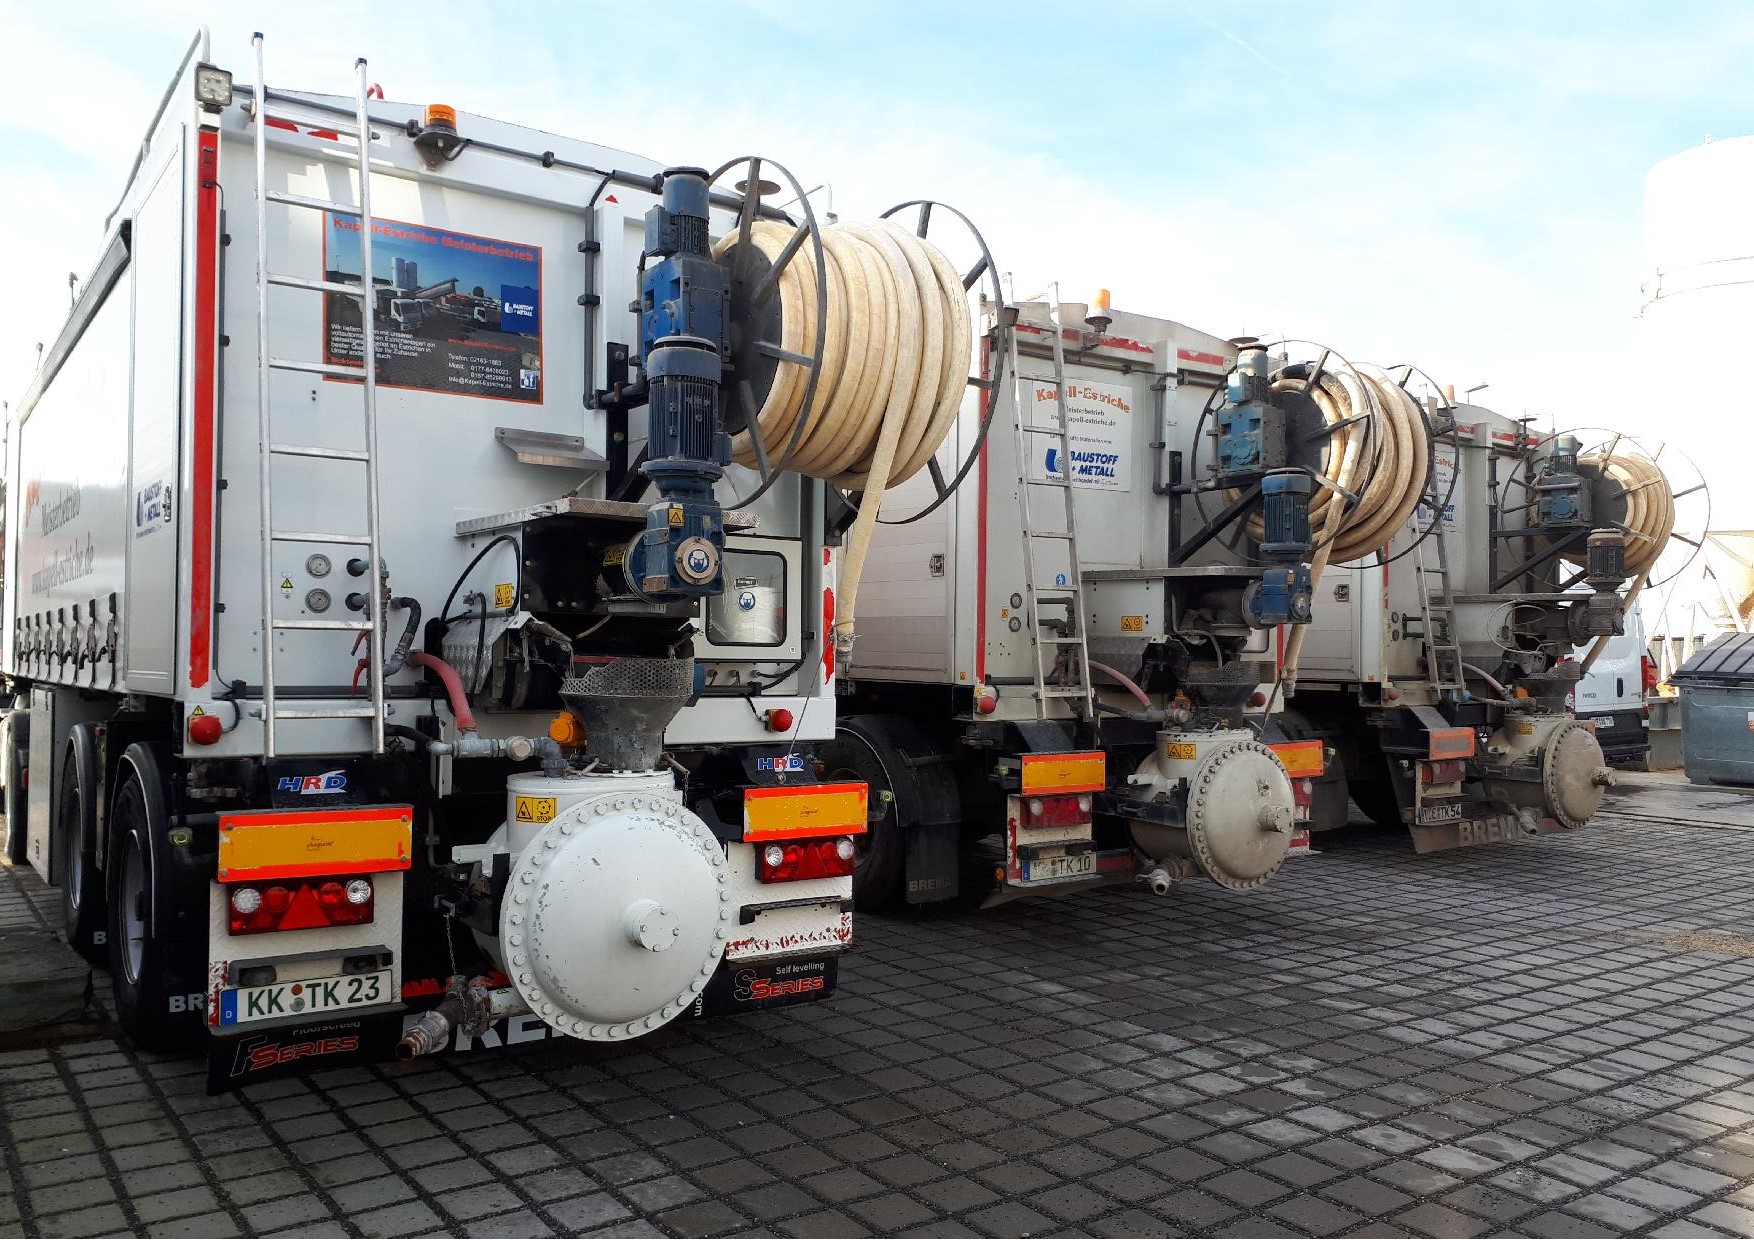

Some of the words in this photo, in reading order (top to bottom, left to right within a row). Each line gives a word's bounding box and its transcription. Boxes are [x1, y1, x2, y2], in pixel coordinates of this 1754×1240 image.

[1077, 464, 1116, 478] METALL
[757, 757, 804, 771] HRD
[277, 774, 347, 793] HRD
[1058, 859, 1074, 875] TK
[1077, 855, 1091, 873] 10
[775, 965, 791, 975] Self
[792, 962, 825, 974] levelling
[247, 986, 286, 1018] KK
[304, 979, 342, 1009] TK
[347, 974, 381, 1004] 23
